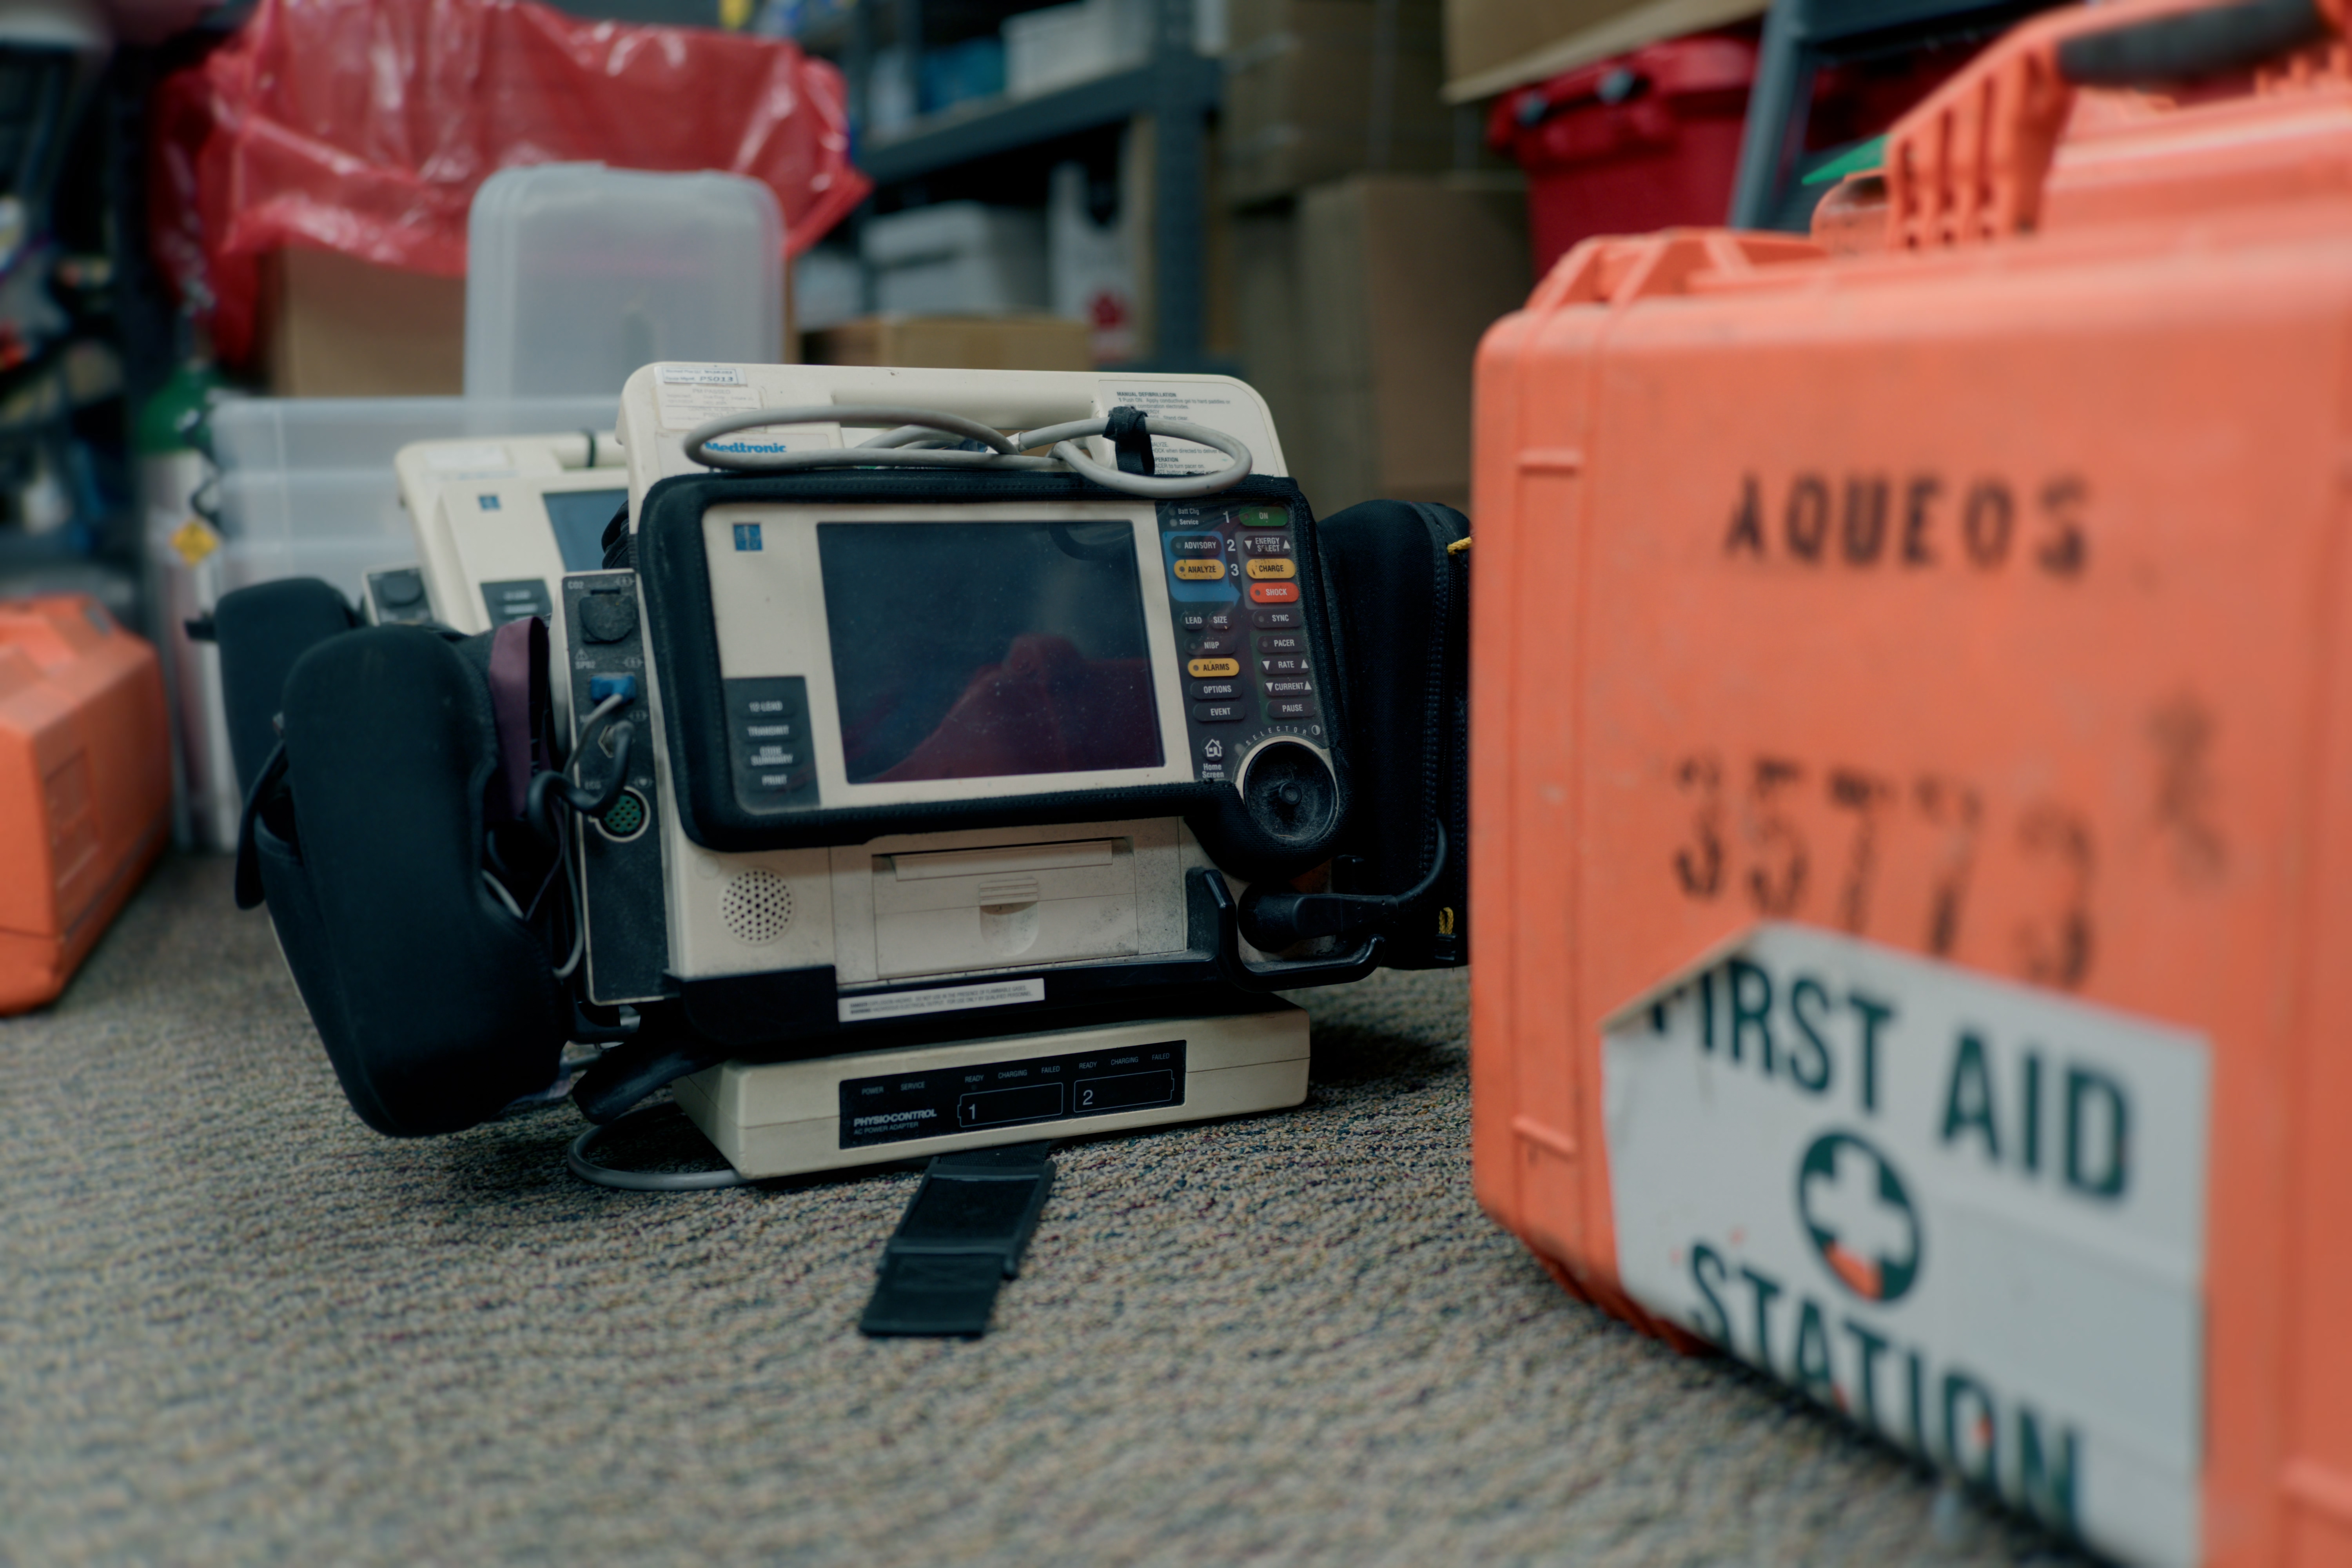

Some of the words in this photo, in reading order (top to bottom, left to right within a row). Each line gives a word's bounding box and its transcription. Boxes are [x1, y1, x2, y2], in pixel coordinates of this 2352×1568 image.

[705, 442, 787, 453] Medtronic
[1223, 511, 1230, 523] 1
[1723, 472, 2091, 579] AQUEOS
[1184, 541, 1216, 550] ADVISORY
[1227, 539, 1236, 552] 2
[1230, 564, 1239, 577] 3
[1203, 685, 1232, 694] OPTIONS
[1274, 682, 1304, 691] CURRENT
[1210, 708, 1231, 716] EVENT
[1246, 726, 1307, 746] SELECTOR
[1079, 1061, 1098, 1069] READY
[1111, 1056, 1139, 1065] CHARGING
[965, 1074, 984, 1083] READY
[998, 1069, 1027, 1079] CHARGING
[1041, 1065, 1060, 1074] FAILED
[862, 1086, 884, 1095] POWER
[900, 1081, 925, 1091] SERVICE
[1651, 957, 1899, 1116] IRST
[1940, 1025, 2132, 1207] AID
[1083, 1089, 1093, 1106] 2
[969, 1103, 975, 1120] 1
[864, 1125, 888, 1134] POWER
[889, 1121, 919, 1131] ADAPTER
[1689, 1241, 2077, 1527] STATION
